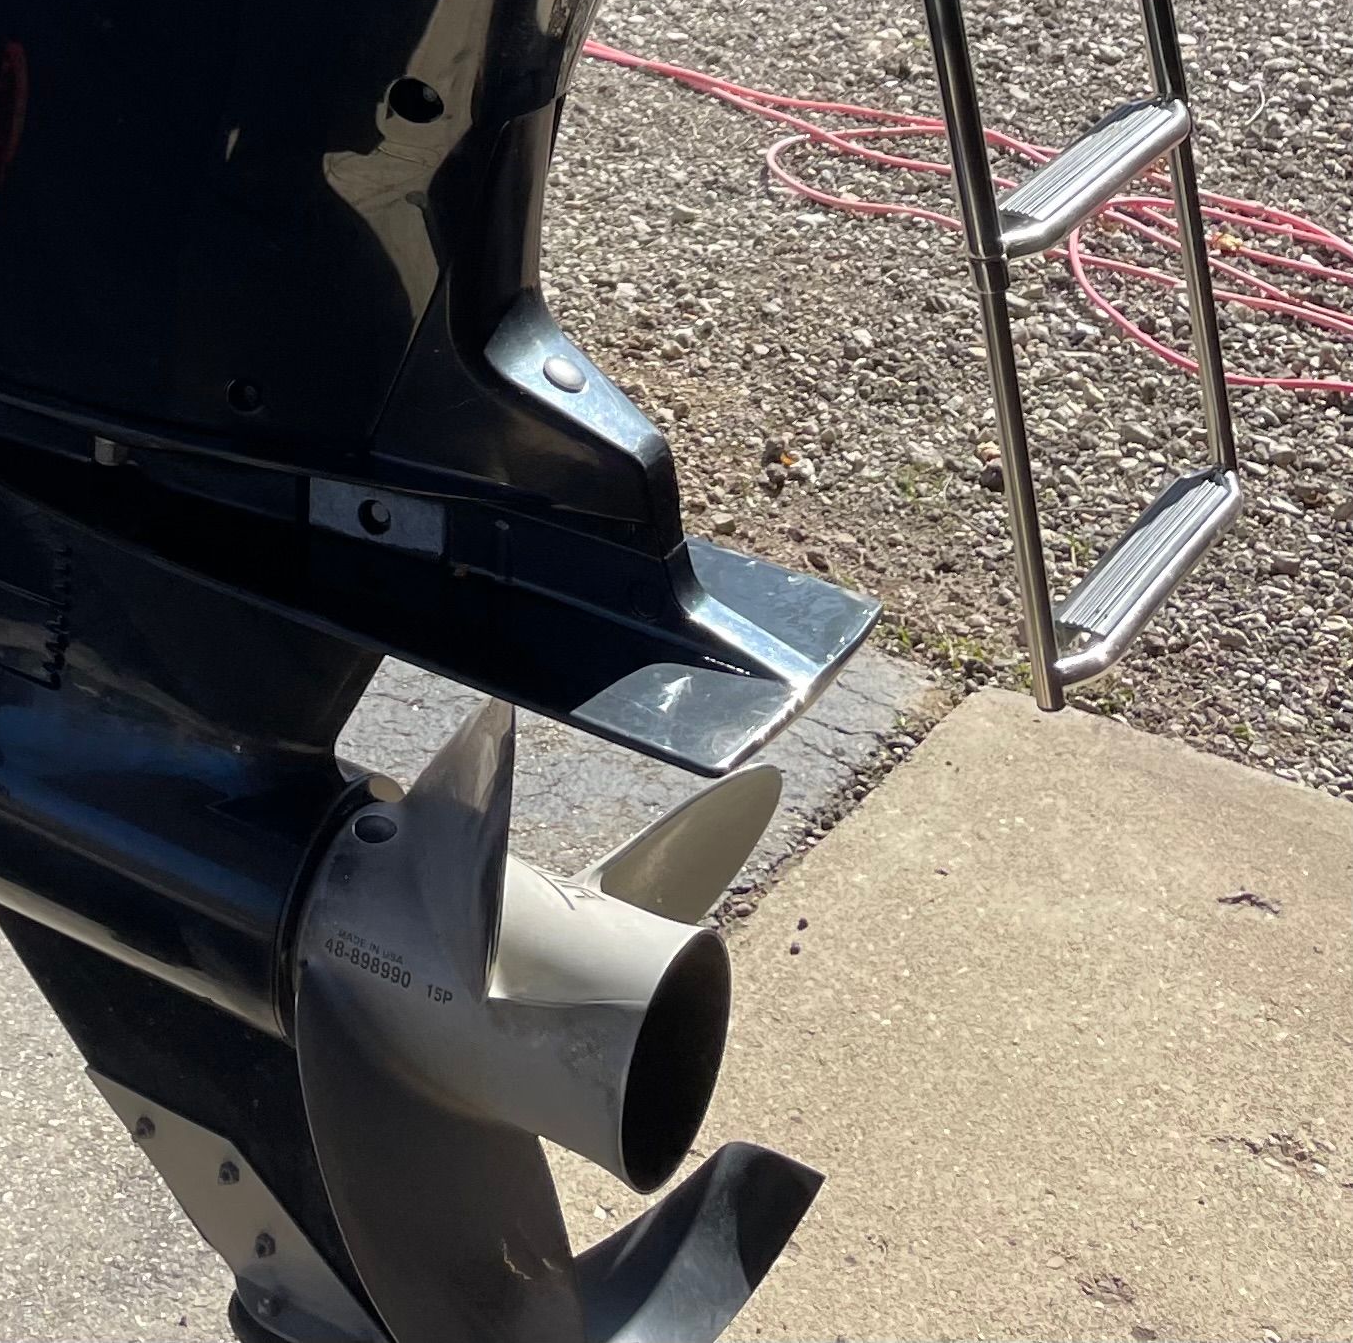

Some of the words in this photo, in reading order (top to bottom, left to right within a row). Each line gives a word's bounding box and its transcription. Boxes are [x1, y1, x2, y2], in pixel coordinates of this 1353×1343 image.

[325, 938, 412, 989] 48-898990
[426, 983, 454, 1005] 15P
[338, 929, 367, 949] MADE
[369, 941, 380, 955] IN
[383, 949, 404, 966] USA
